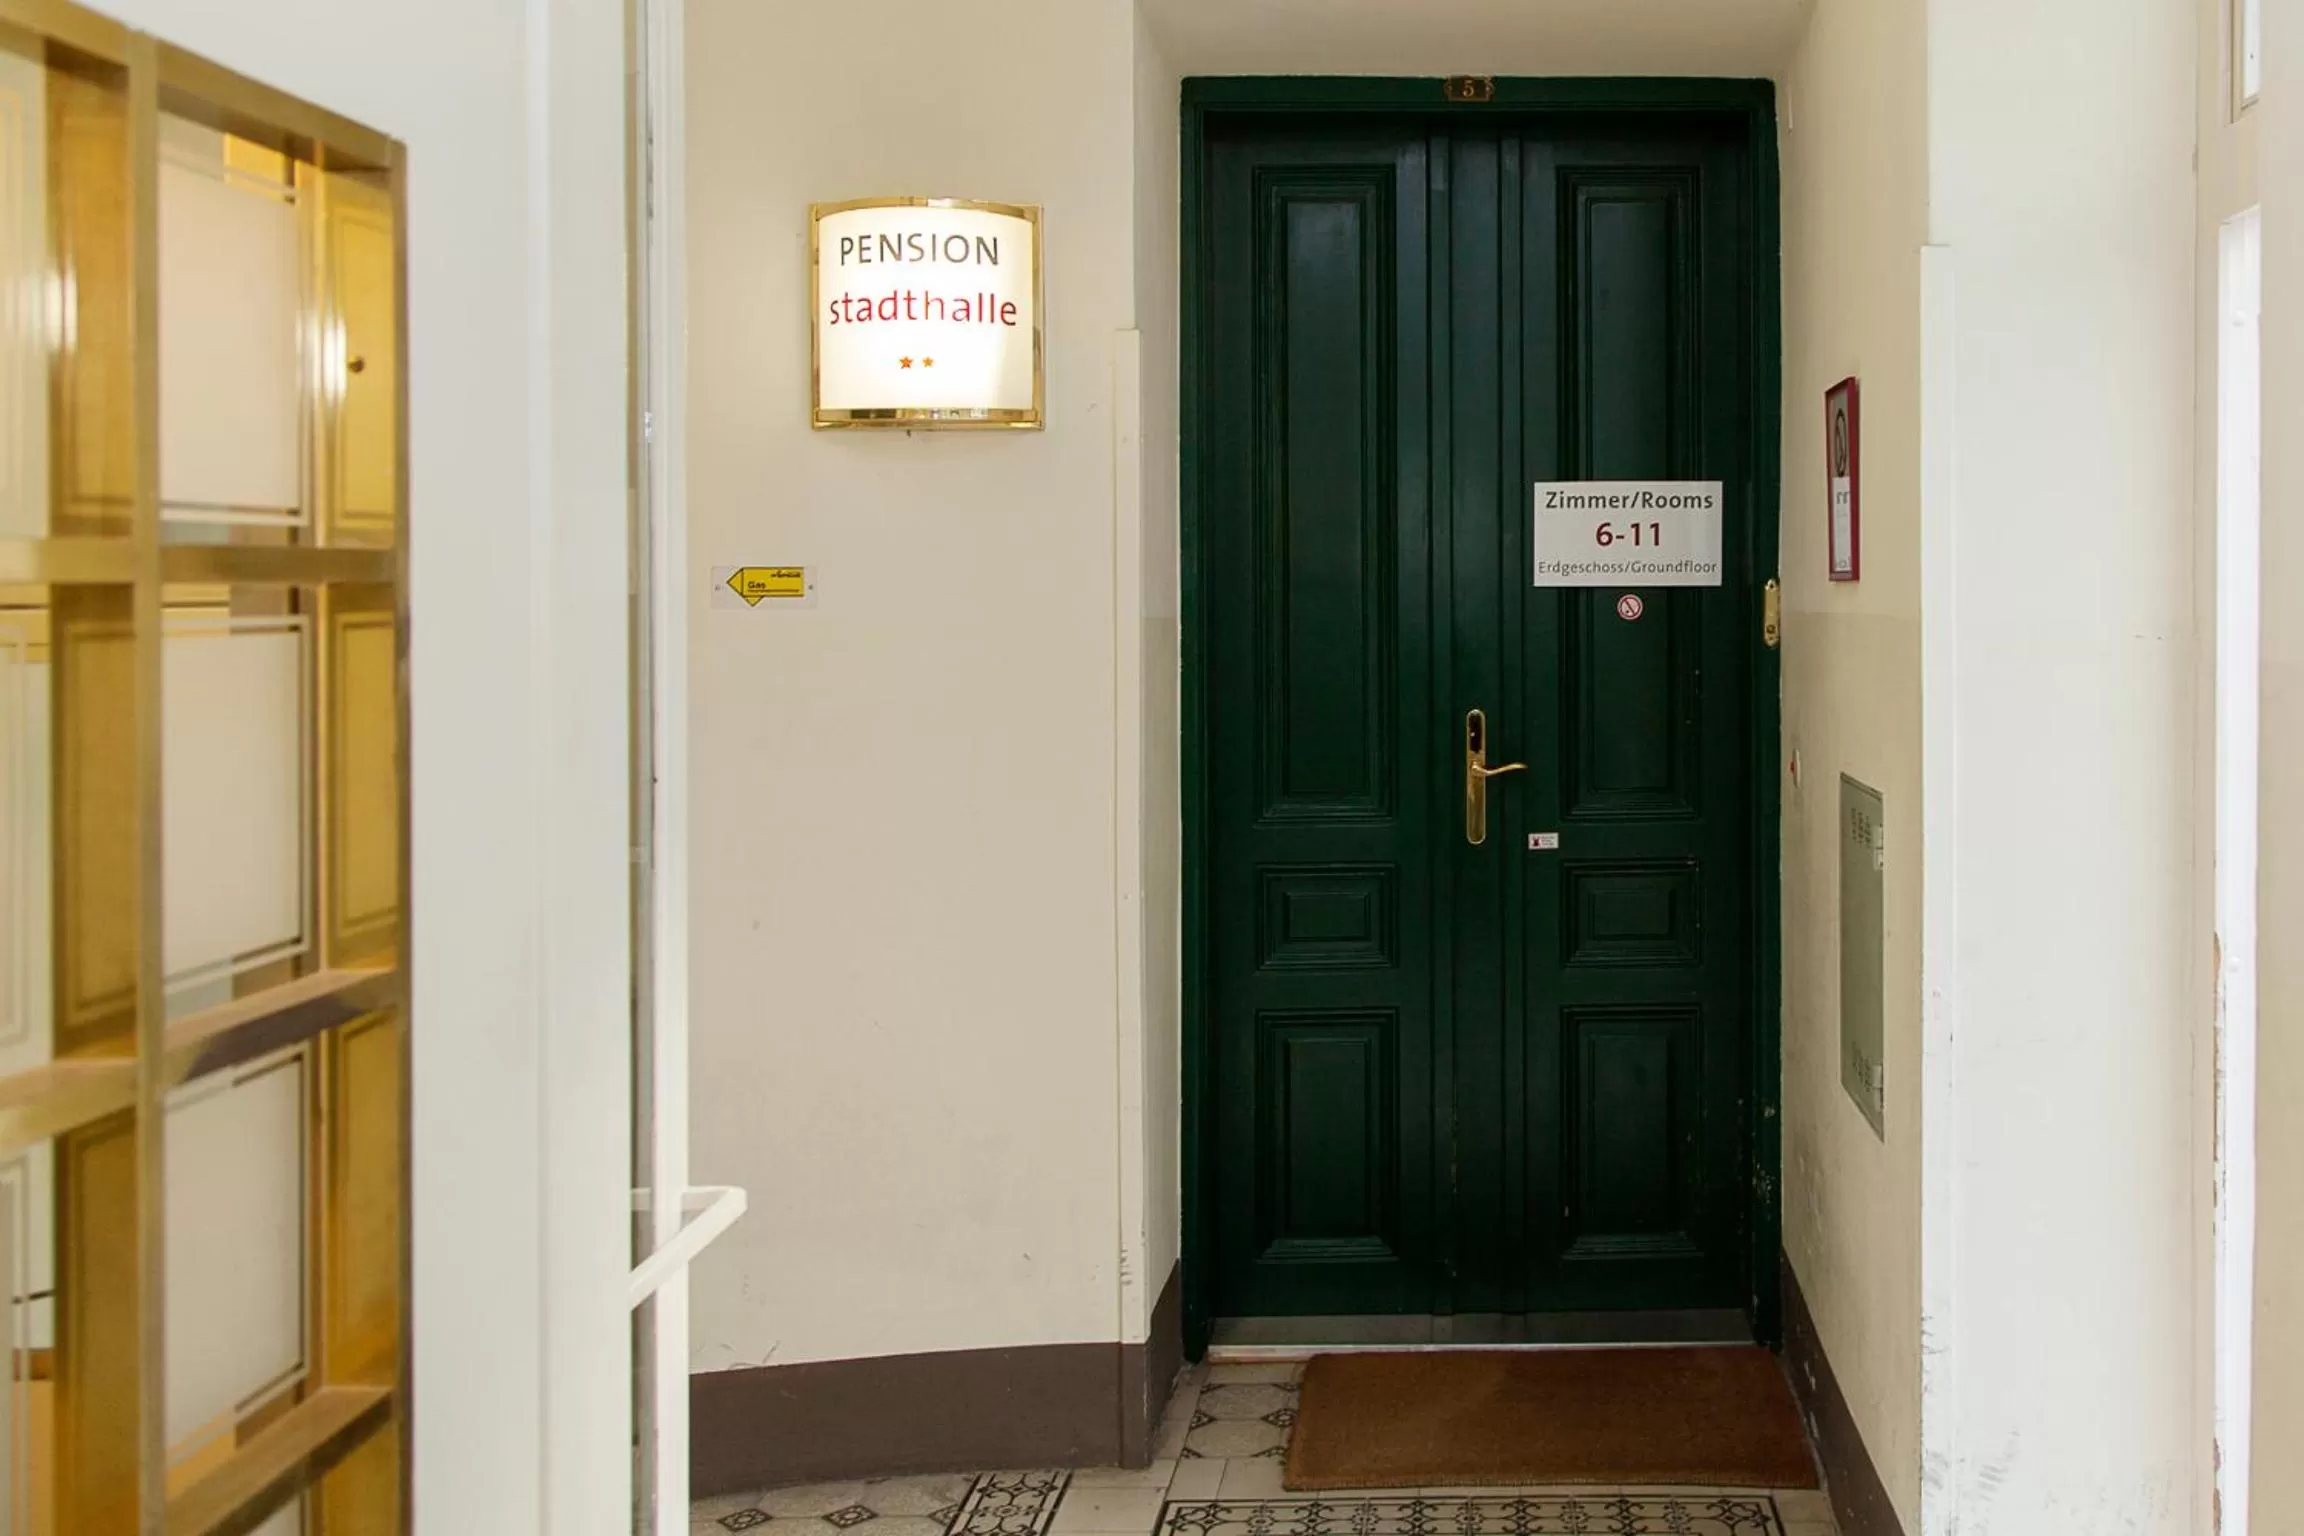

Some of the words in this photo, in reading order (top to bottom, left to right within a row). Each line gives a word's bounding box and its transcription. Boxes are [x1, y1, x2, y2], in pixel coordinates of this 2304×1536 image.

[1462, 79, 1475, 98] 5
[840, 232, 999, 266] PENSION
[829, 289, 1017, 326] stadthalle
[1545, 491, 1713, 509] Zimmer/Rooms
[1596, 522, 1661, 547] 6-11
[1538, 560, 1718, 576] Erdgeschoss/Groundfloor
[747, 580, 767, 590] Gas
